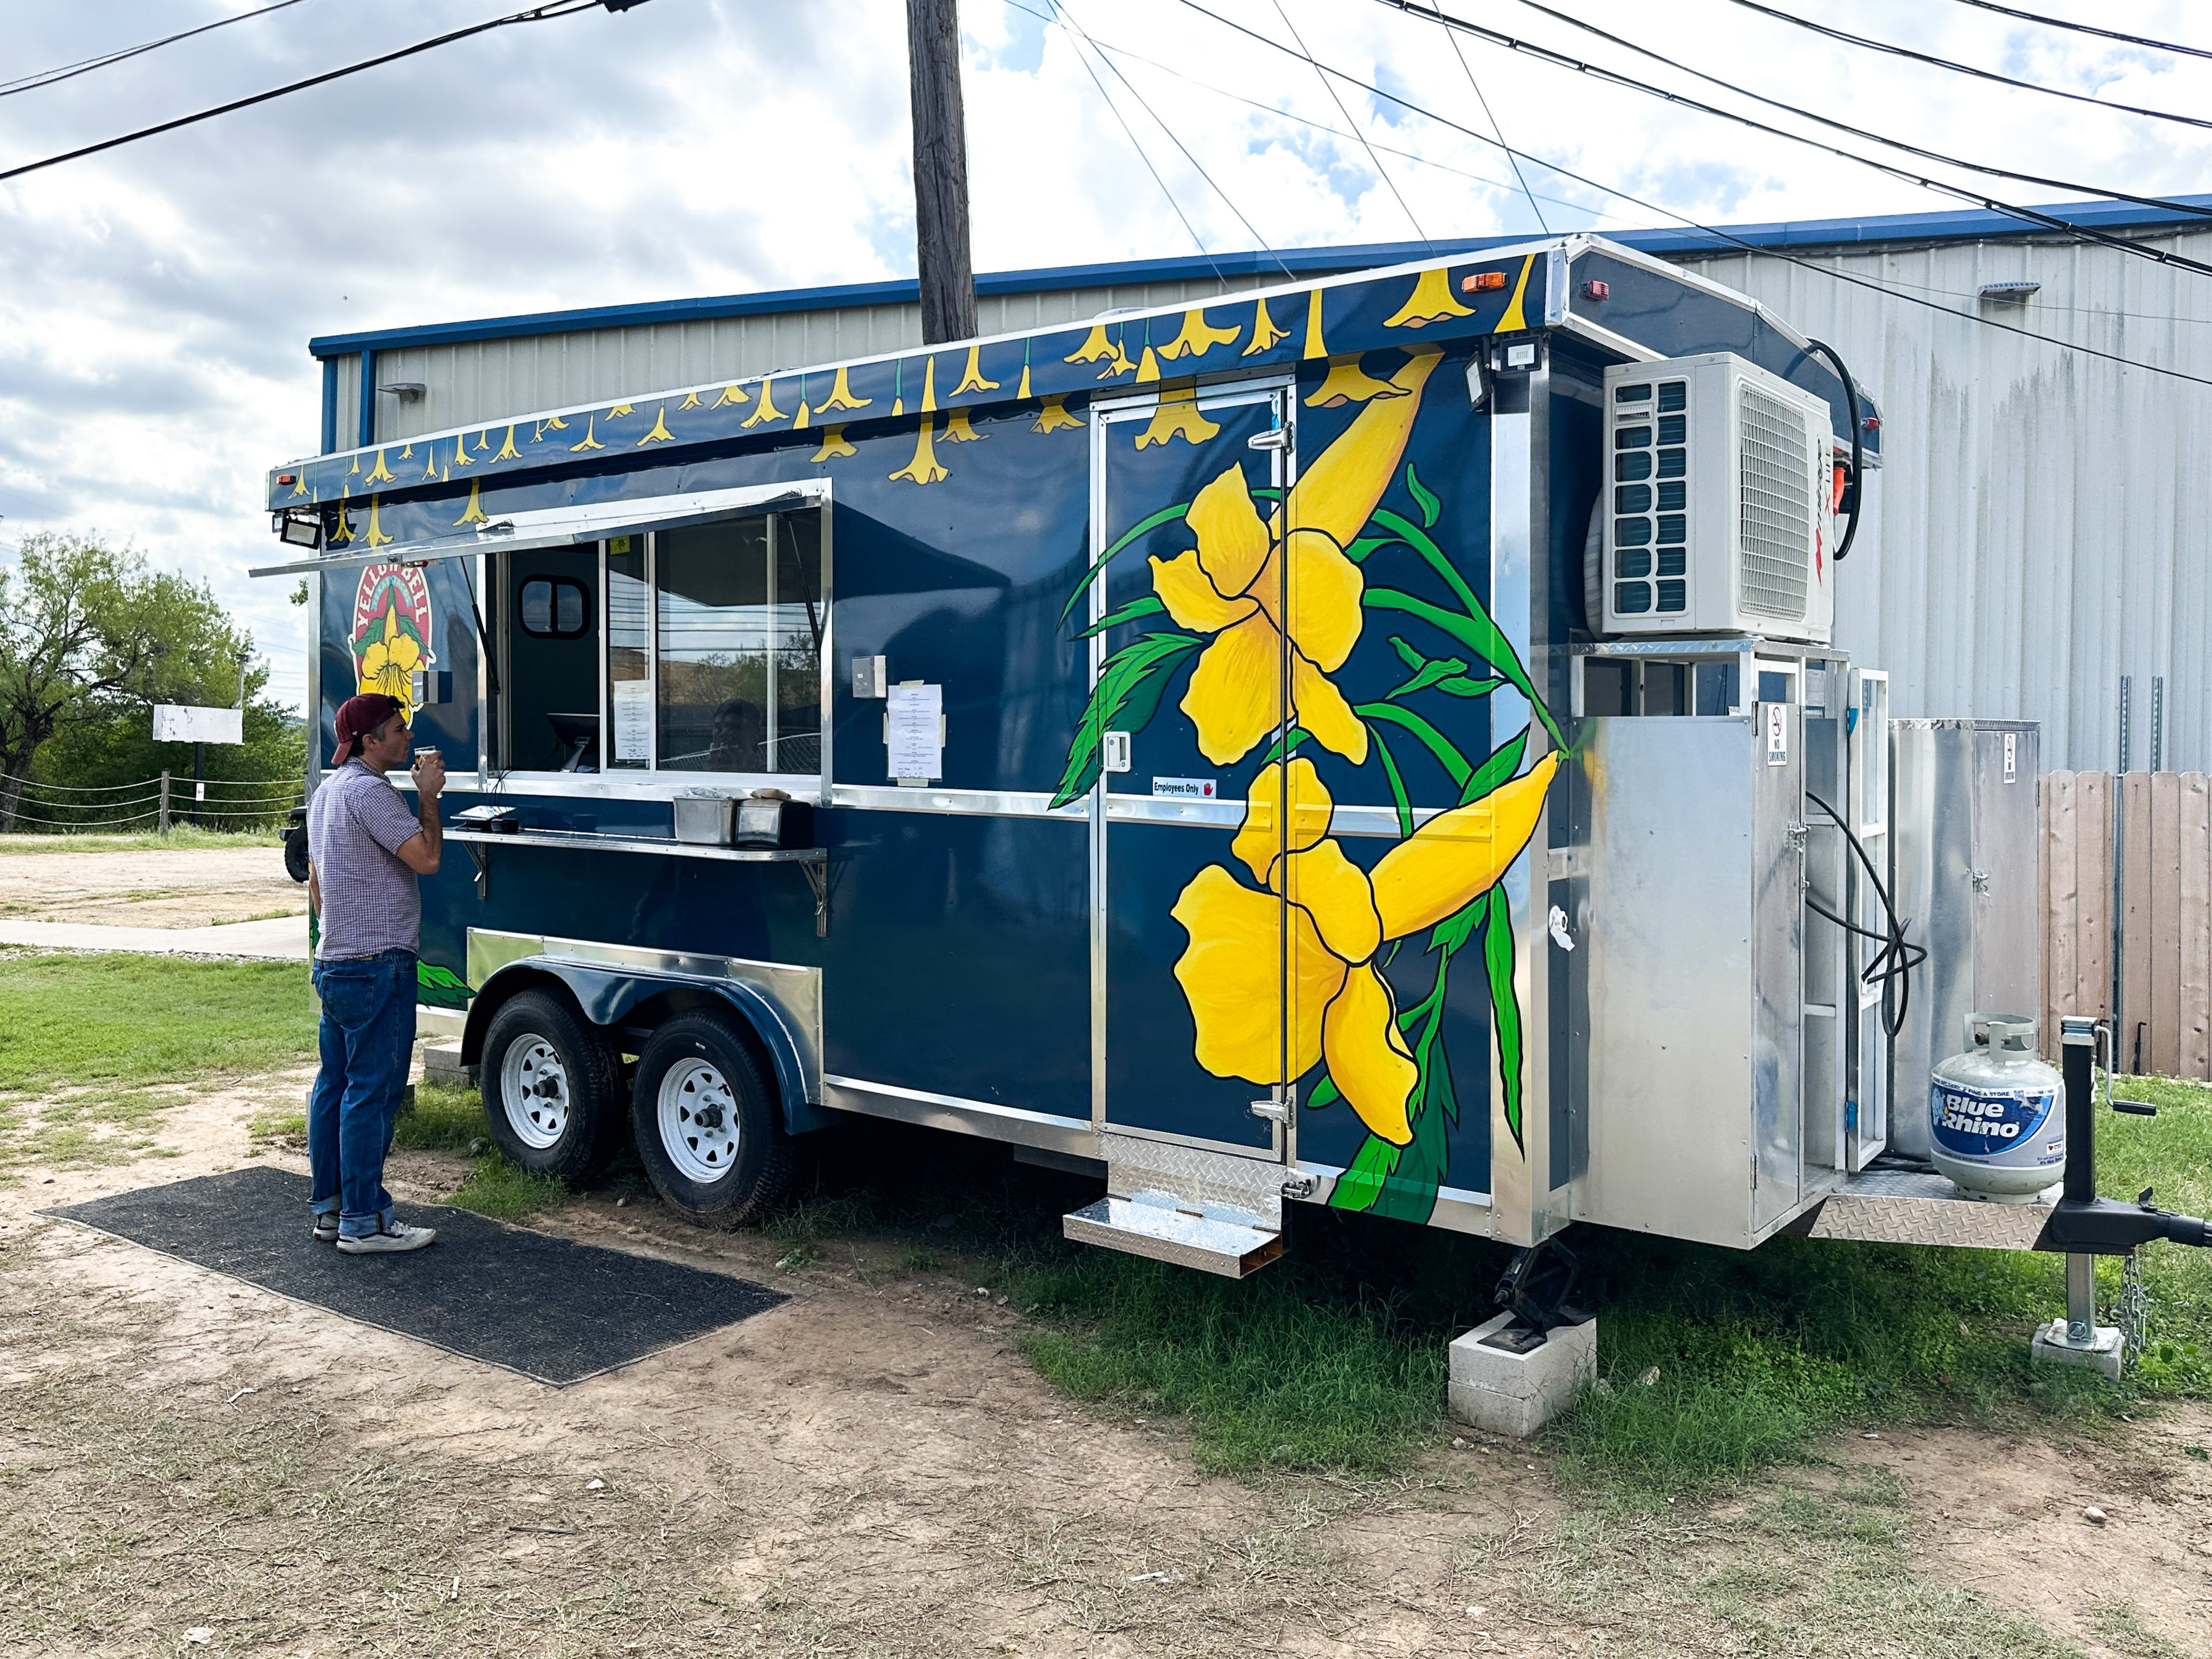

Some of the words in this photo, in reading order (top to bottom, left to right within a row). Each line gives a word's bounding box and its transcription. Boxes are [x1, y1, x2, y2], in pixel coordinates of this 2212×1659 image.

[357, 563, 399, 628] YELLO
[401, 567, 427, 623] BELL
[1774, 739, 1780, 749] NO
[1769, 751, 1786, 762] SMOKING
[1154, 782, 1184, 794] Employees
[1186, 783, 1199, 796] Only
[1946, 1094, 2005, 1118] Blue
[1942, 1113, 2020, 1138] Rhino
